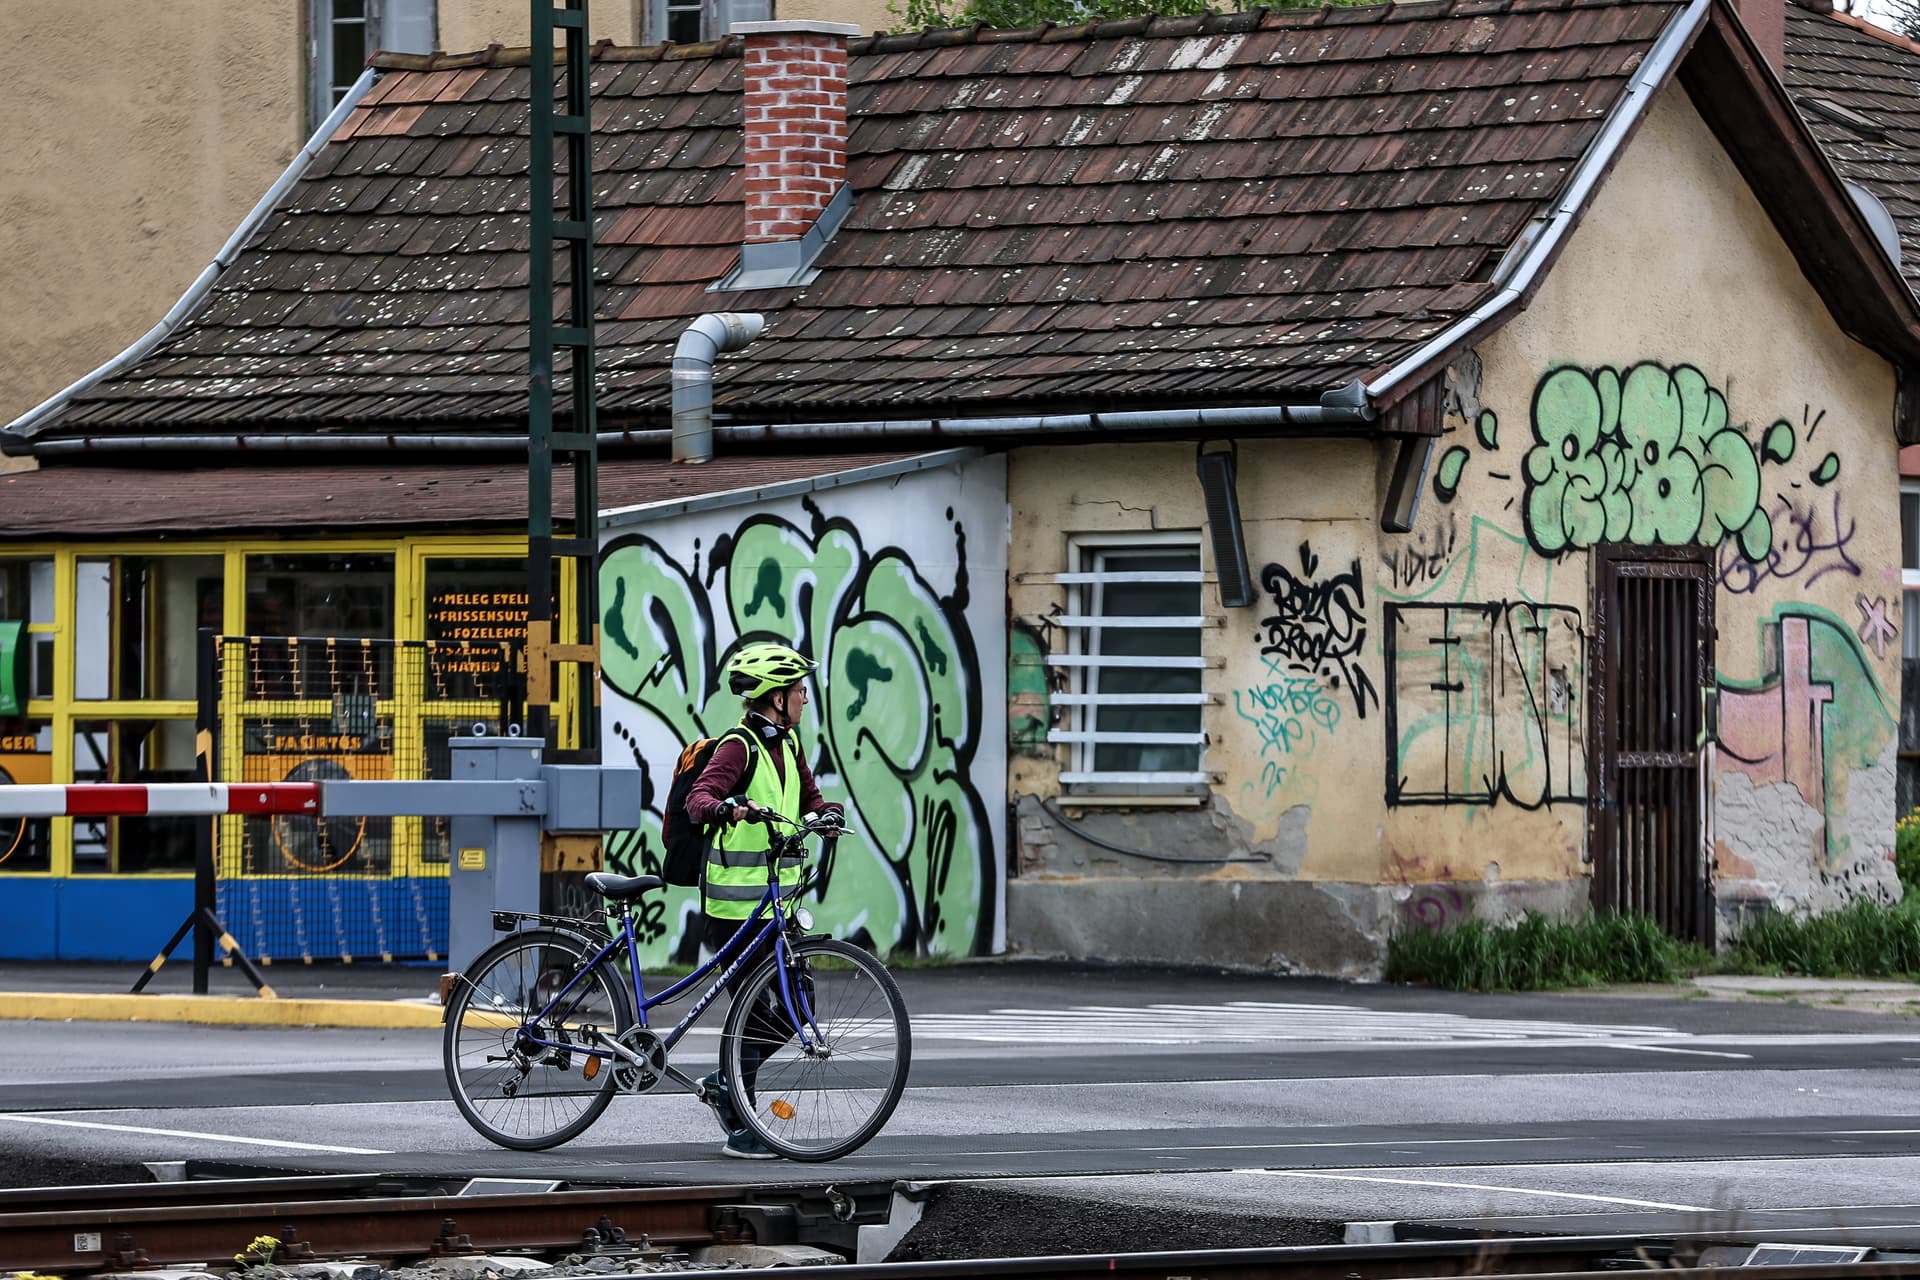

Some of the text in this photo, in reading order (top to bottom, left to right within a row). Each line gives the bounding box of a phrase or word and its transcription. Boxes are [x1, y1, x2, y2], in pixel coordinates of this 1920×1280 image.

[444, 593, 529, 605] MELEG ETEL
[0, 735, 36, 750] GER
[679, 960, 739, 1029] SCHWINN
